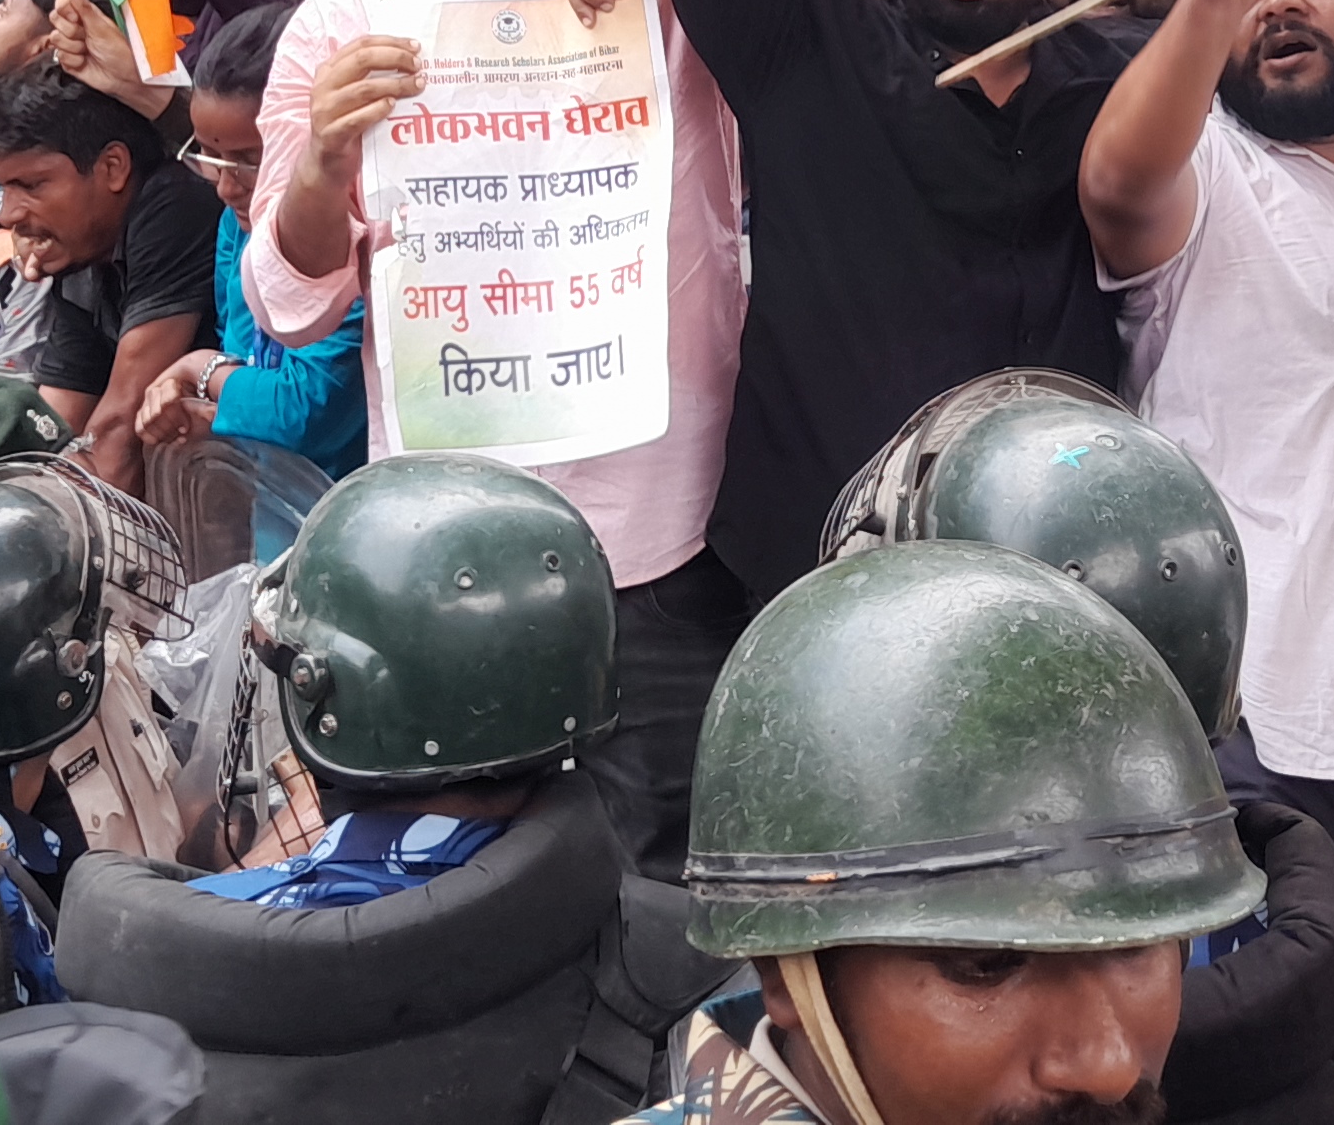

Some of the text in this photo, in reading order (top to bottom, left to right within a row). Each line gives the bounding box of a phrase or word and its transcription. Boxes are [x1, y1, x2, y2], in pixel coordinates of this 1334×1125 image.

[434, 57, 465, 69] Holders
[474, 56, 510, 68] Research
[511, 54, 545, 68] Scholars
[547, 49, 588, 66] Association
[589, 48, 597, 58] of
[598, 45, 620, 57] Bihar
[483, 71, 520, 84] आमरण
[388, 94, 650, 146] लोकभवन घेराव
[405, 161, 640, 208] सहायक प्राध्यापक
[434, 220, 526, 255] अभ्यर्थियों
[532, 219, 560, 249] की
[569, 208, 650, 245] अधिकतम
[403, 244, 645, 333] आयु सीमा 55 वर्ष
[439, 333, 626, 397] किया जाए।
